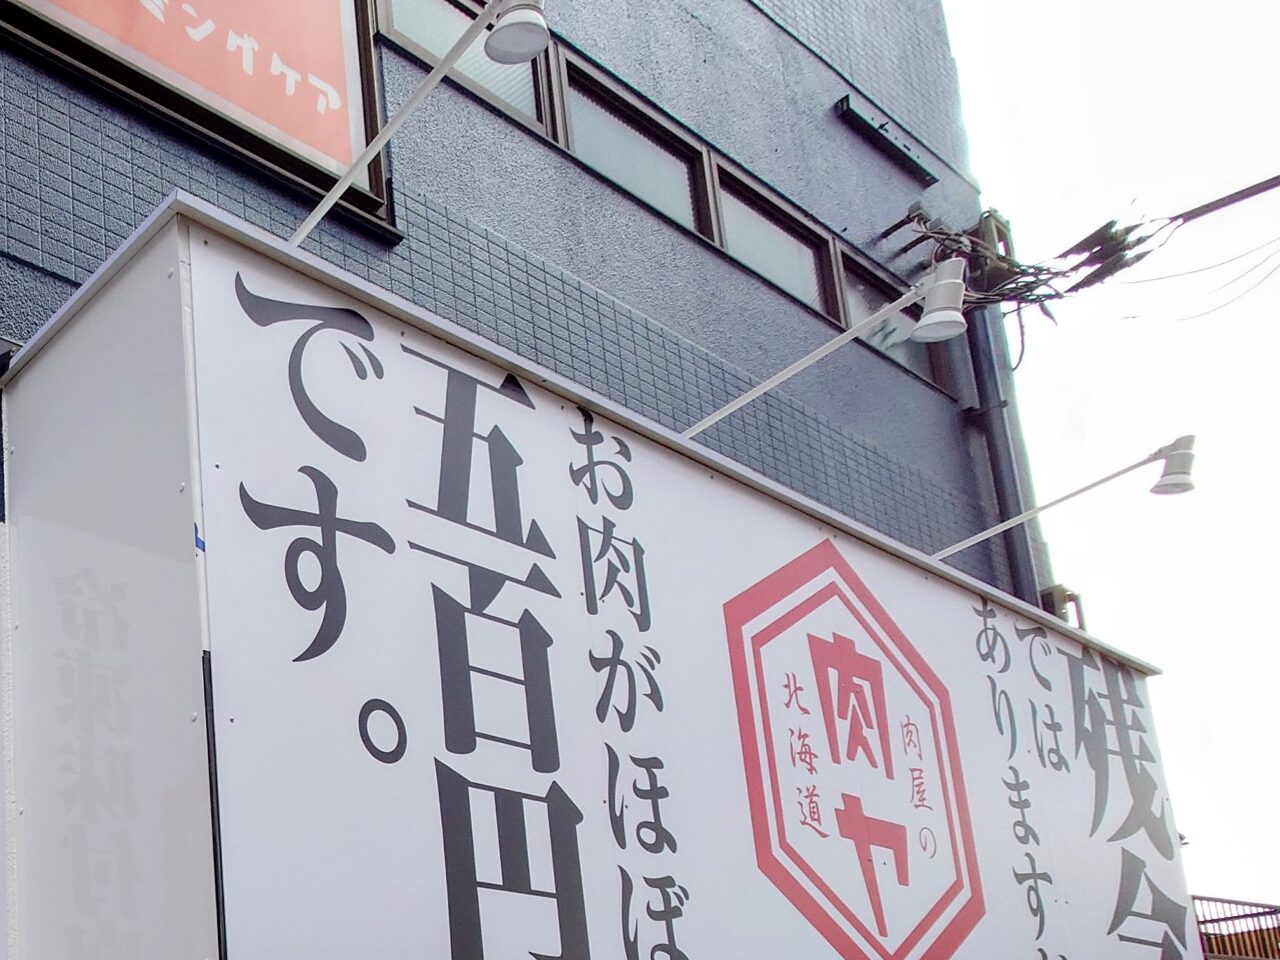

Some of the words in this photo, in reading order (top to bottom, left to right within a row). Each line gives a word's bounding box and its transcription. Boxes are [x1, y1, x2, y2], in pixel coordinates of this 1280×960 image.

[235, 270, 408, 765] です。
[782, 671, 830, 839] 北海道
[1014, 621, 1071, 774] では
[900, 714, 938, 860] 肉屋の
